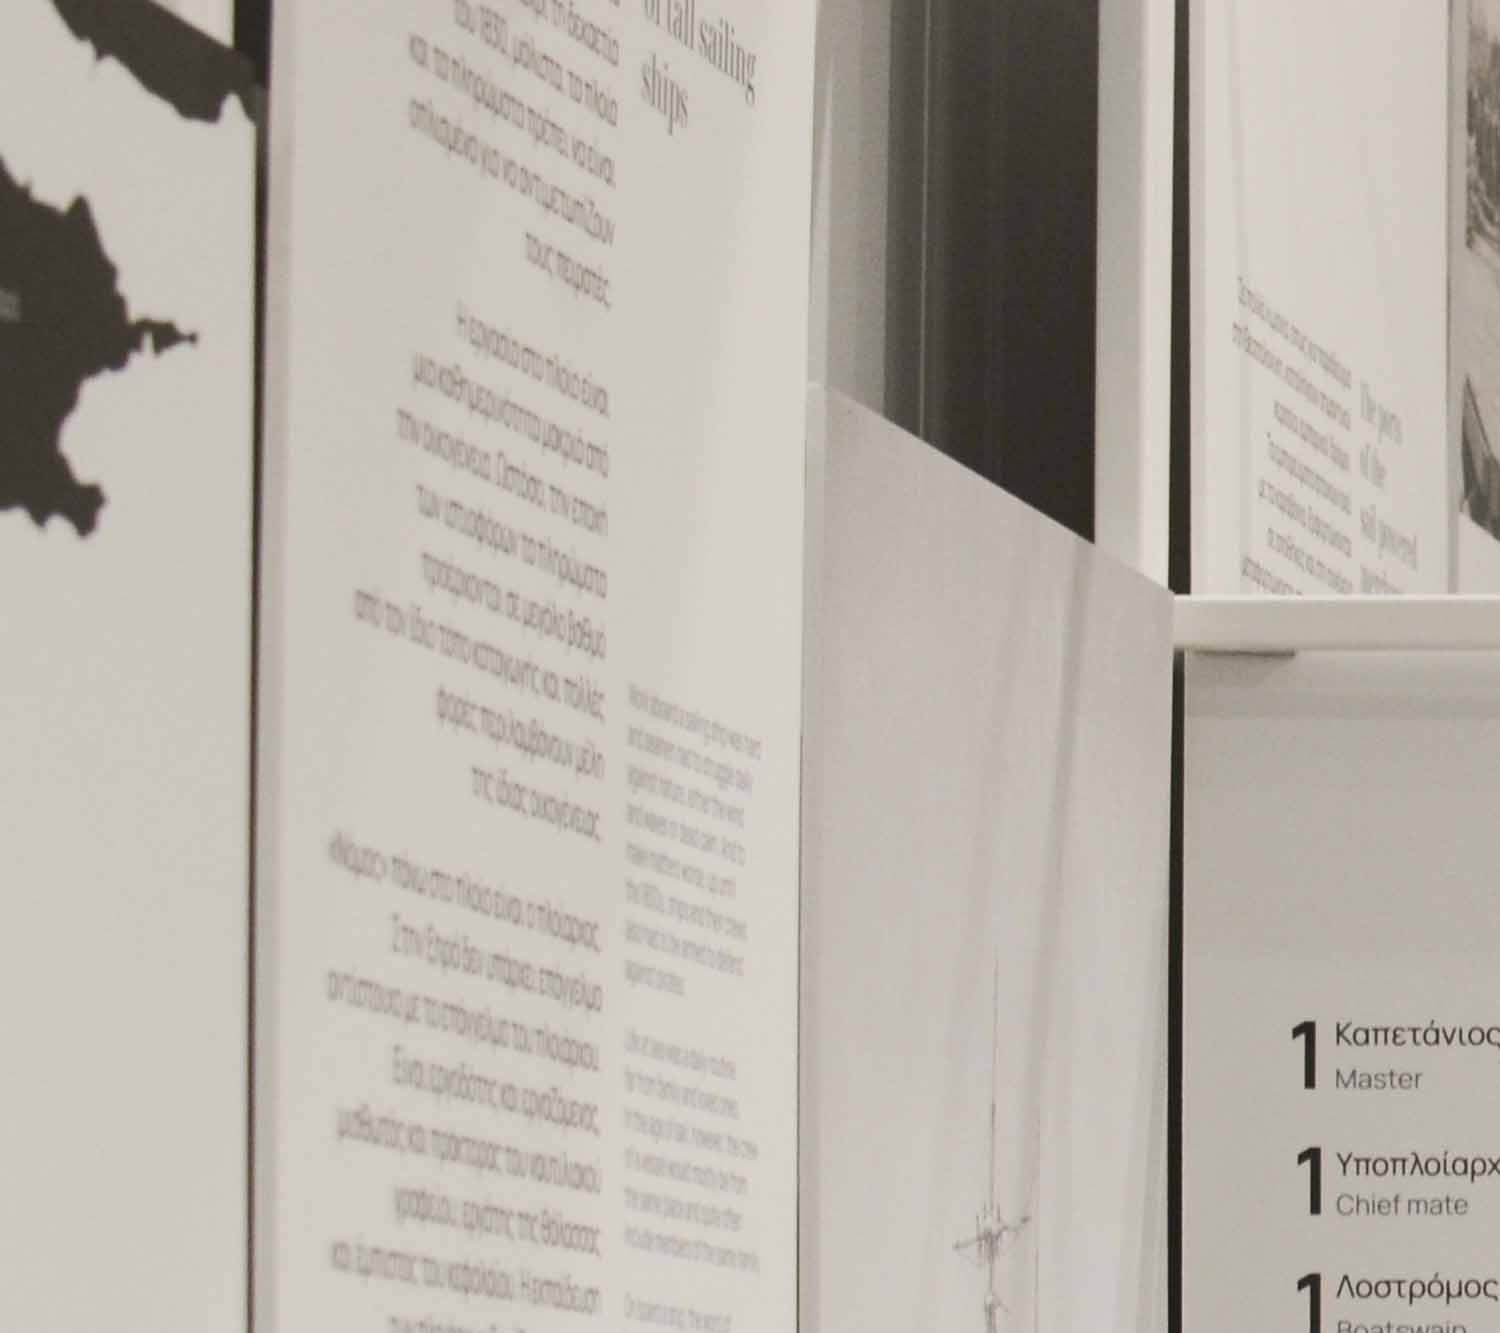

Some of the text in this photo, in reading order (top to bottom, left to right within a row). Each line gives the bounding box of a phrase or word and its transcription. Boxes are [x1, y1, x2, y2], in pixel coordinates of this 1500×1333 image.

[641, 51, 689, 136] ships
[698, 16, 758, 107] sailing
[1292, 1021, 1316, 1090] 1
[1336, 1069, 1422, 1090] Master
[1297, 1147, 1321, 1215] 1
[1336, 1193, 1468, 1216] Chief mate
[1336, 1273, 1498, 1306] Λοστρόμος
